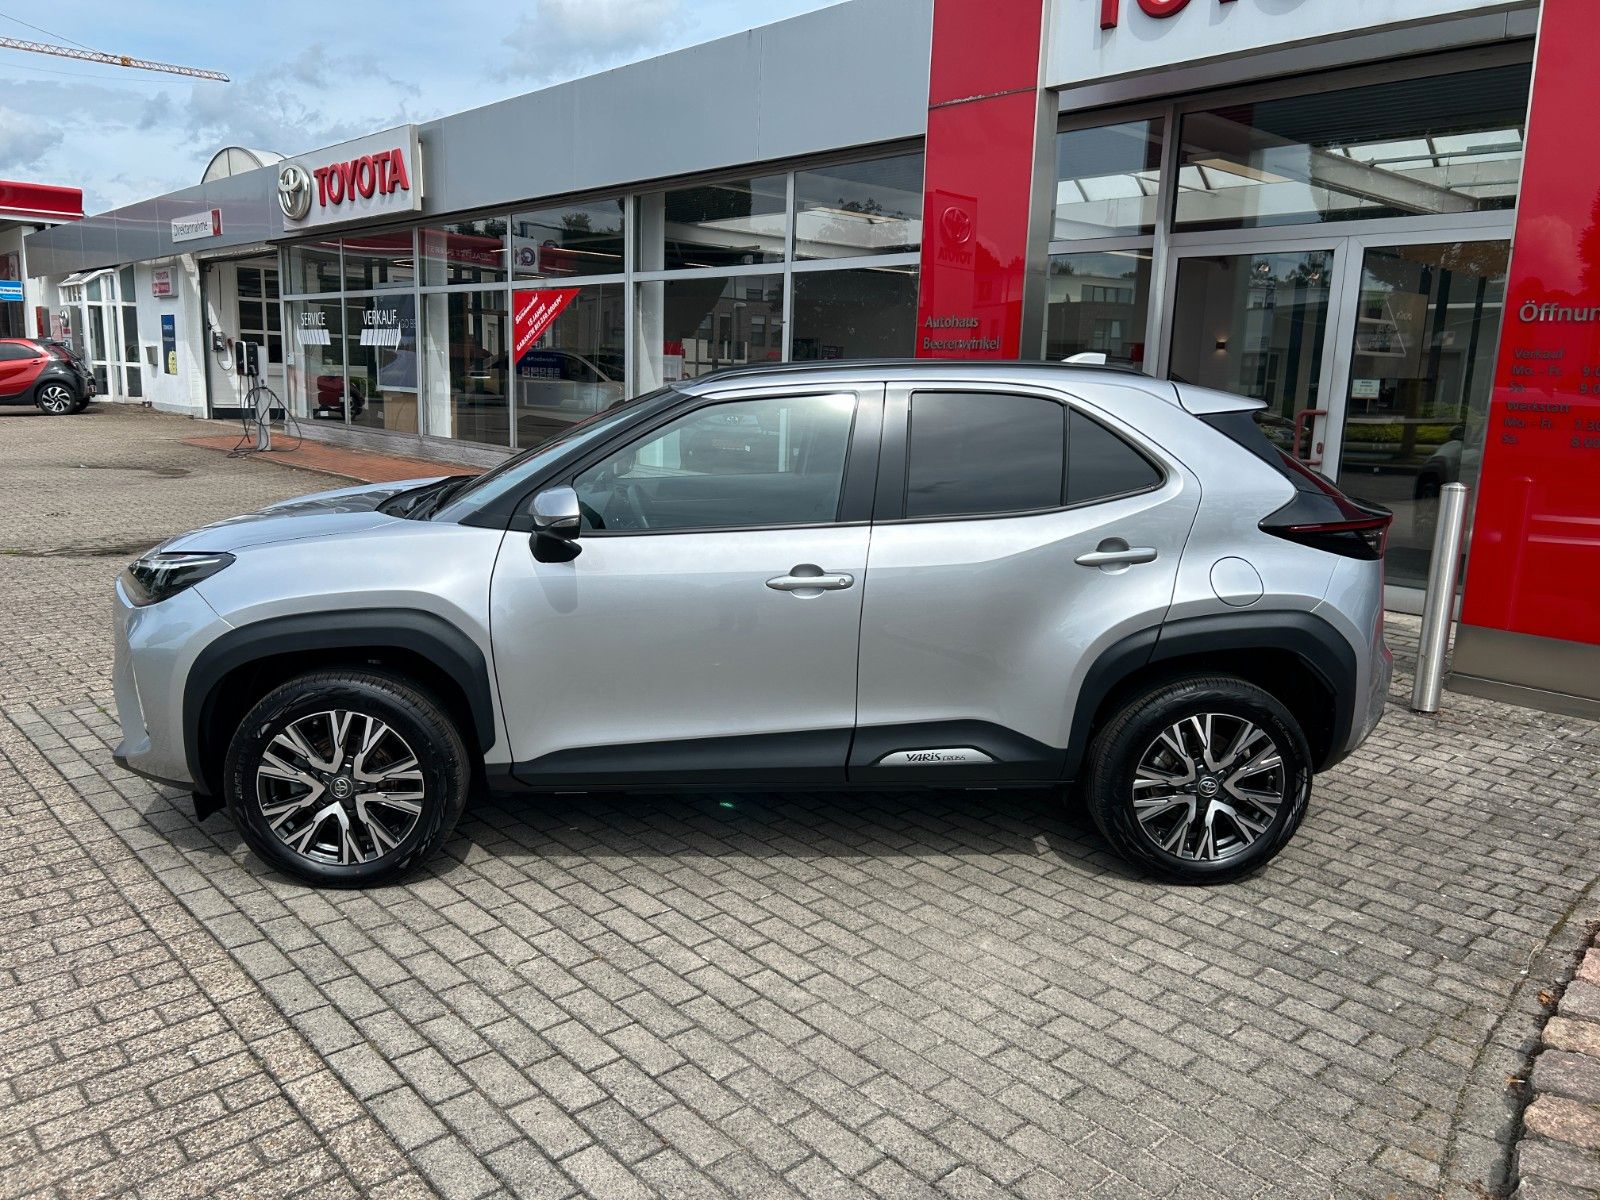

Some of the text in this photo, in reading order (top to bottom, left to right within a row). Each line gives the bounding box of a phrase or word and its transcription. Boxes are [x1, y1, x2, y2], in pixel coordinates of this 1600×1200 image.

[313, 148, 409, 206] TOYOTA
[300, 311, 326, 326] SERVICE
[362, 309, 397, 325] VERKAUF
[925, 315, 979, 328] Autohaus
[924, 337, 1000, 350] Beerenwinkel
[1514, 347, 1564, 360] Verkauf
[1507, 400, 1569, 413] Werkstatt
